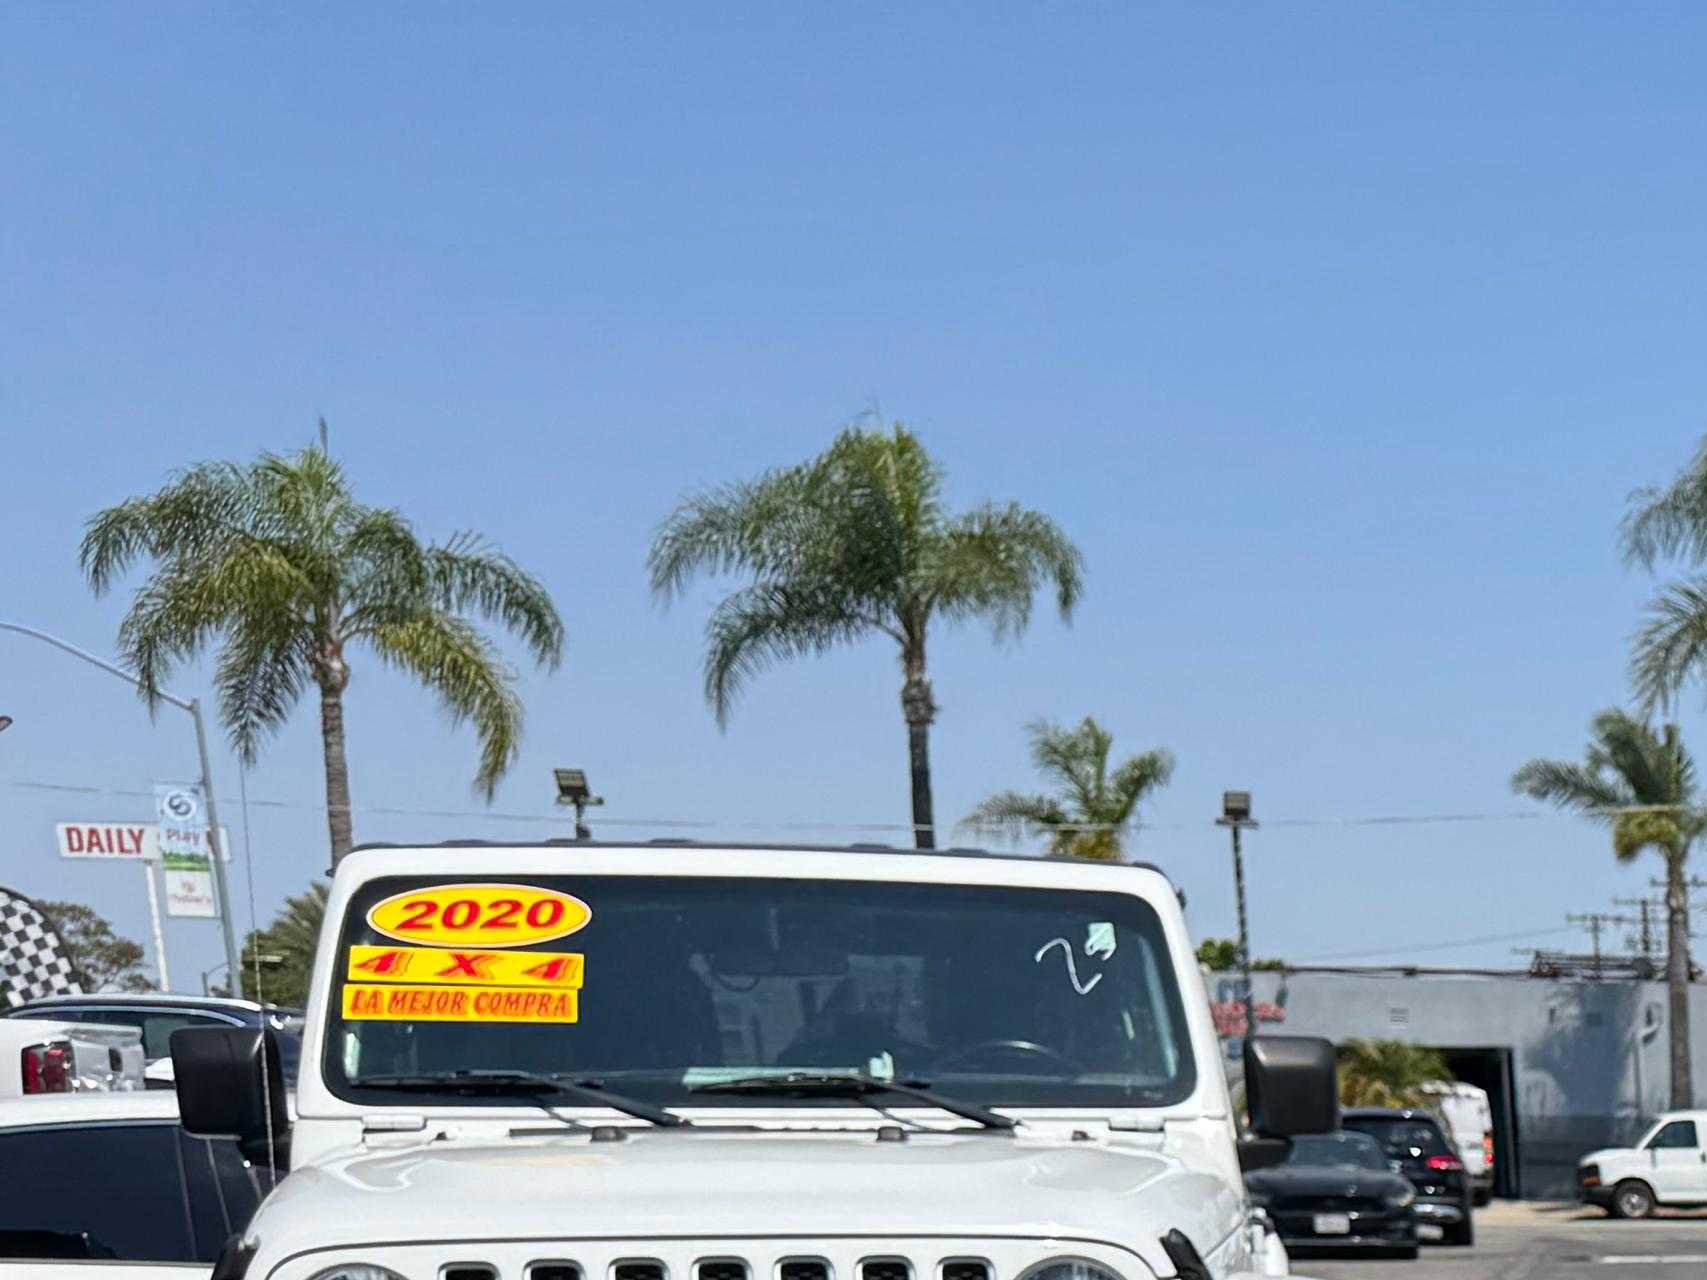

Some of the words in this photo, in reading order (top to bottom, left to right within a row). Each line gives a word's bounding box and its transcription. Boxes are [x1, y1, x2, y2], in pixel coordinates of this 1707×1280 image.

[65, 827, 144, 854] DAILY
[394, 899, 565, 931] 2020
[354, 951, 413, 976] 4
[521, 958, 577, 981] 4
[351, 989, 383, 1015] LA
[388, 990, 469, 1016] MEJOR
[473, 991, 573, 1018] COMPRA
